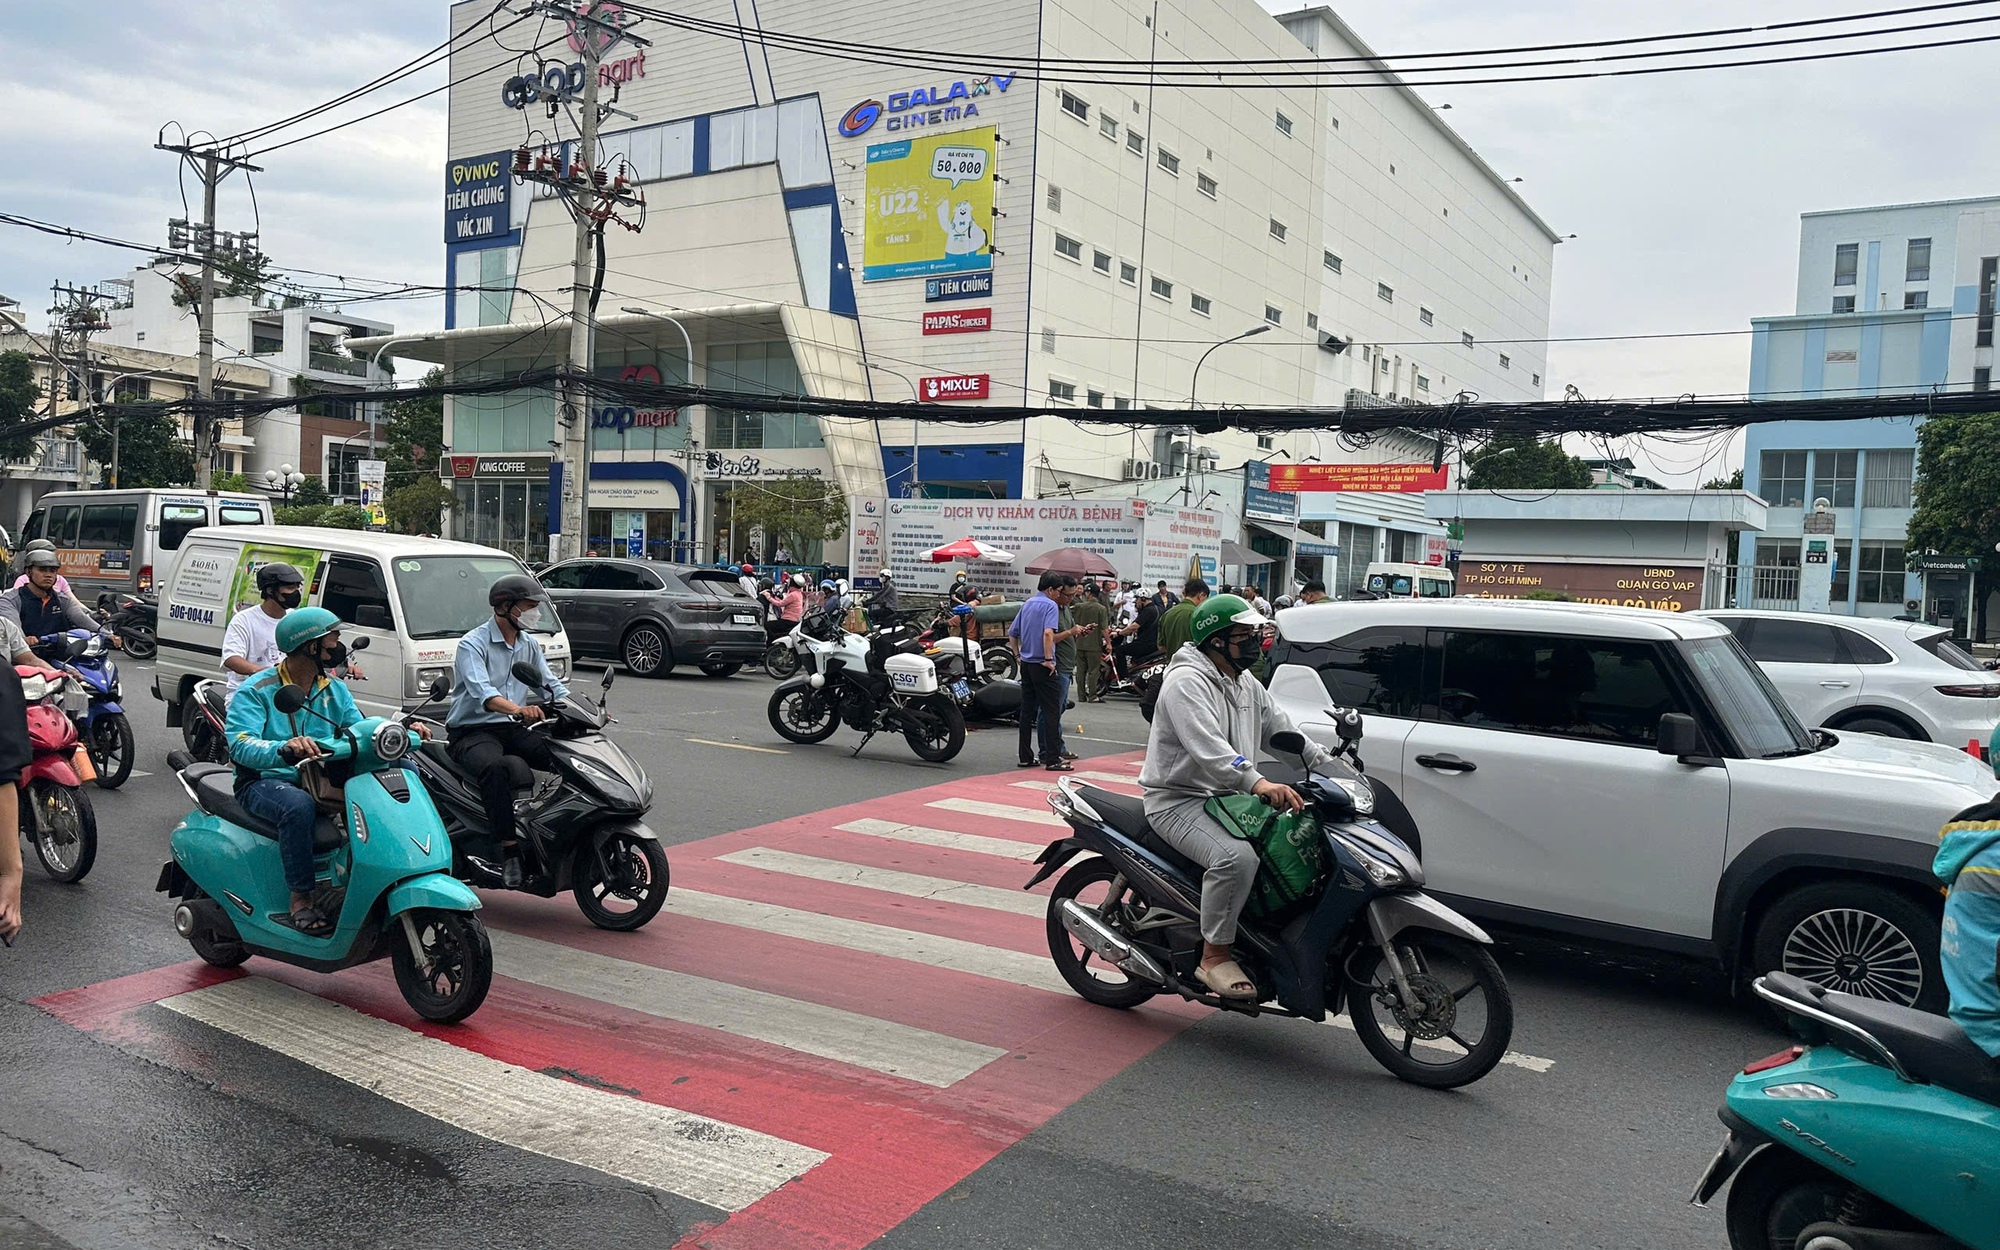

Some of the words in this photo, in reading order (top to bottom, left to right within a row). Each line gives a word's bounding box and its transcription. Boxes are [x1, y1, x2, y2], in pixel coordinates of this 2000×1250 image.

[888, 71, 1017, 112] GALAXY
[887, 104, 979, 131] CINEMA
[464, 161, 499, 182] VNVC
[937, 160, 981, 175] 50.000
[447, 189, 469, 211] TIÊM
[471, 182, 505, 207] CHỦNG
[880, 190, 919, 217] U22
[457, 213, 474, 238] VẮC
[476, 216, 493, 236] XIN
[940, 280, 959, 295] TIÊM
[961, 275, 989, 292] CHỦNG
[960, 318, 987, 327] CHICKEN
[941, 378, 980, 392] MIXUE
[480, 462, 498, 472] KING
[498, 462, 526, 472] COFFEE
[721, 455, 760, 475] GoGi
[944, 506, 973, 521] DỊCH
[977, 506, 994, 521] VỤ
[998, 504, 1034, 519] KHÁM
[1039, 505, 1078, 520] CHỮA
[1082, 504, 1122, 523] BỆNH
[61, 553, 101, 567] LALAMOVE
[1480, 563, 1497, 572] SỞ
[1512, 563, 1526, 573] TẾ
[1922, 562, 1966, 570] Vietcombank
[1465, 575, 1478, 583] TP
[1480, 573, 1495, 584] HỒ
[1498, 574, 1515, 585] CHÍ
[1516, 577, 1542, 585] MINH
[1644, 569, 1675, 578] UBND
[1652, 578, 1670, 590] GÒ
[1648, 595, 1682, 613] VẤP
[170, 604, 214, 625] 50G-004.44
[1196, 614, 1219, 630] Grab
[893, 673, 919, 684] CSGT
[1286, 822, 1317, 847] Grab
